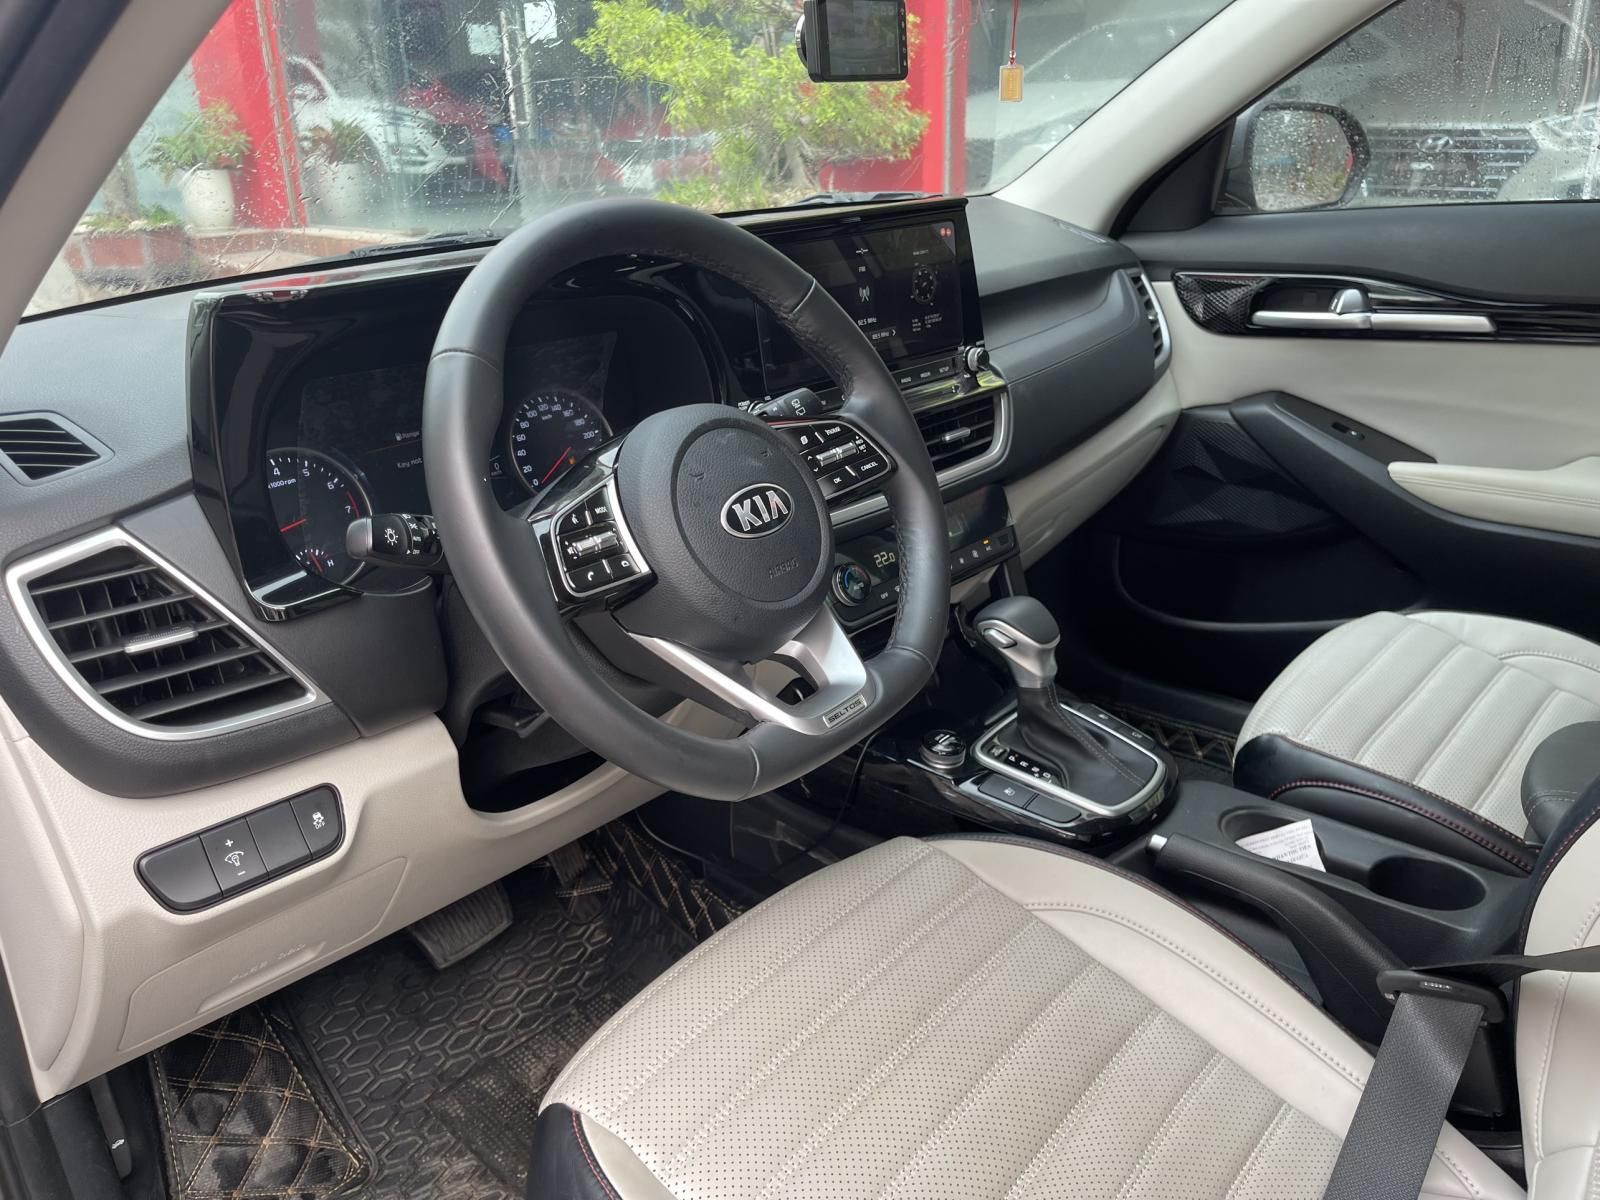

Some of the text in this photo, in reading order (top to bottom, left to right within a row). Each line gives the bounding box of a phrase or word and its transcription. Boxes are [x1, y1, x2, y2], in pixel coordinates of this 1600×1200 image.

[526, 410, 538, 418] 100
[520, 421, 530, 429] 80
[583, 431, 595, 439] 200
[273, 467, 280, 476] 4
[302, 468, 310, 477] 5
[523, 465, 532, 473] 20
[327, 481, 335, 490] 6
[345, 505, 352, 514] 7
[732, 490, 788, 531] KIA
[874, 551, 896, 568] 22.0
[827, 699, 862, 723] SELTOS
[315, 821, 326, 830] OFF
